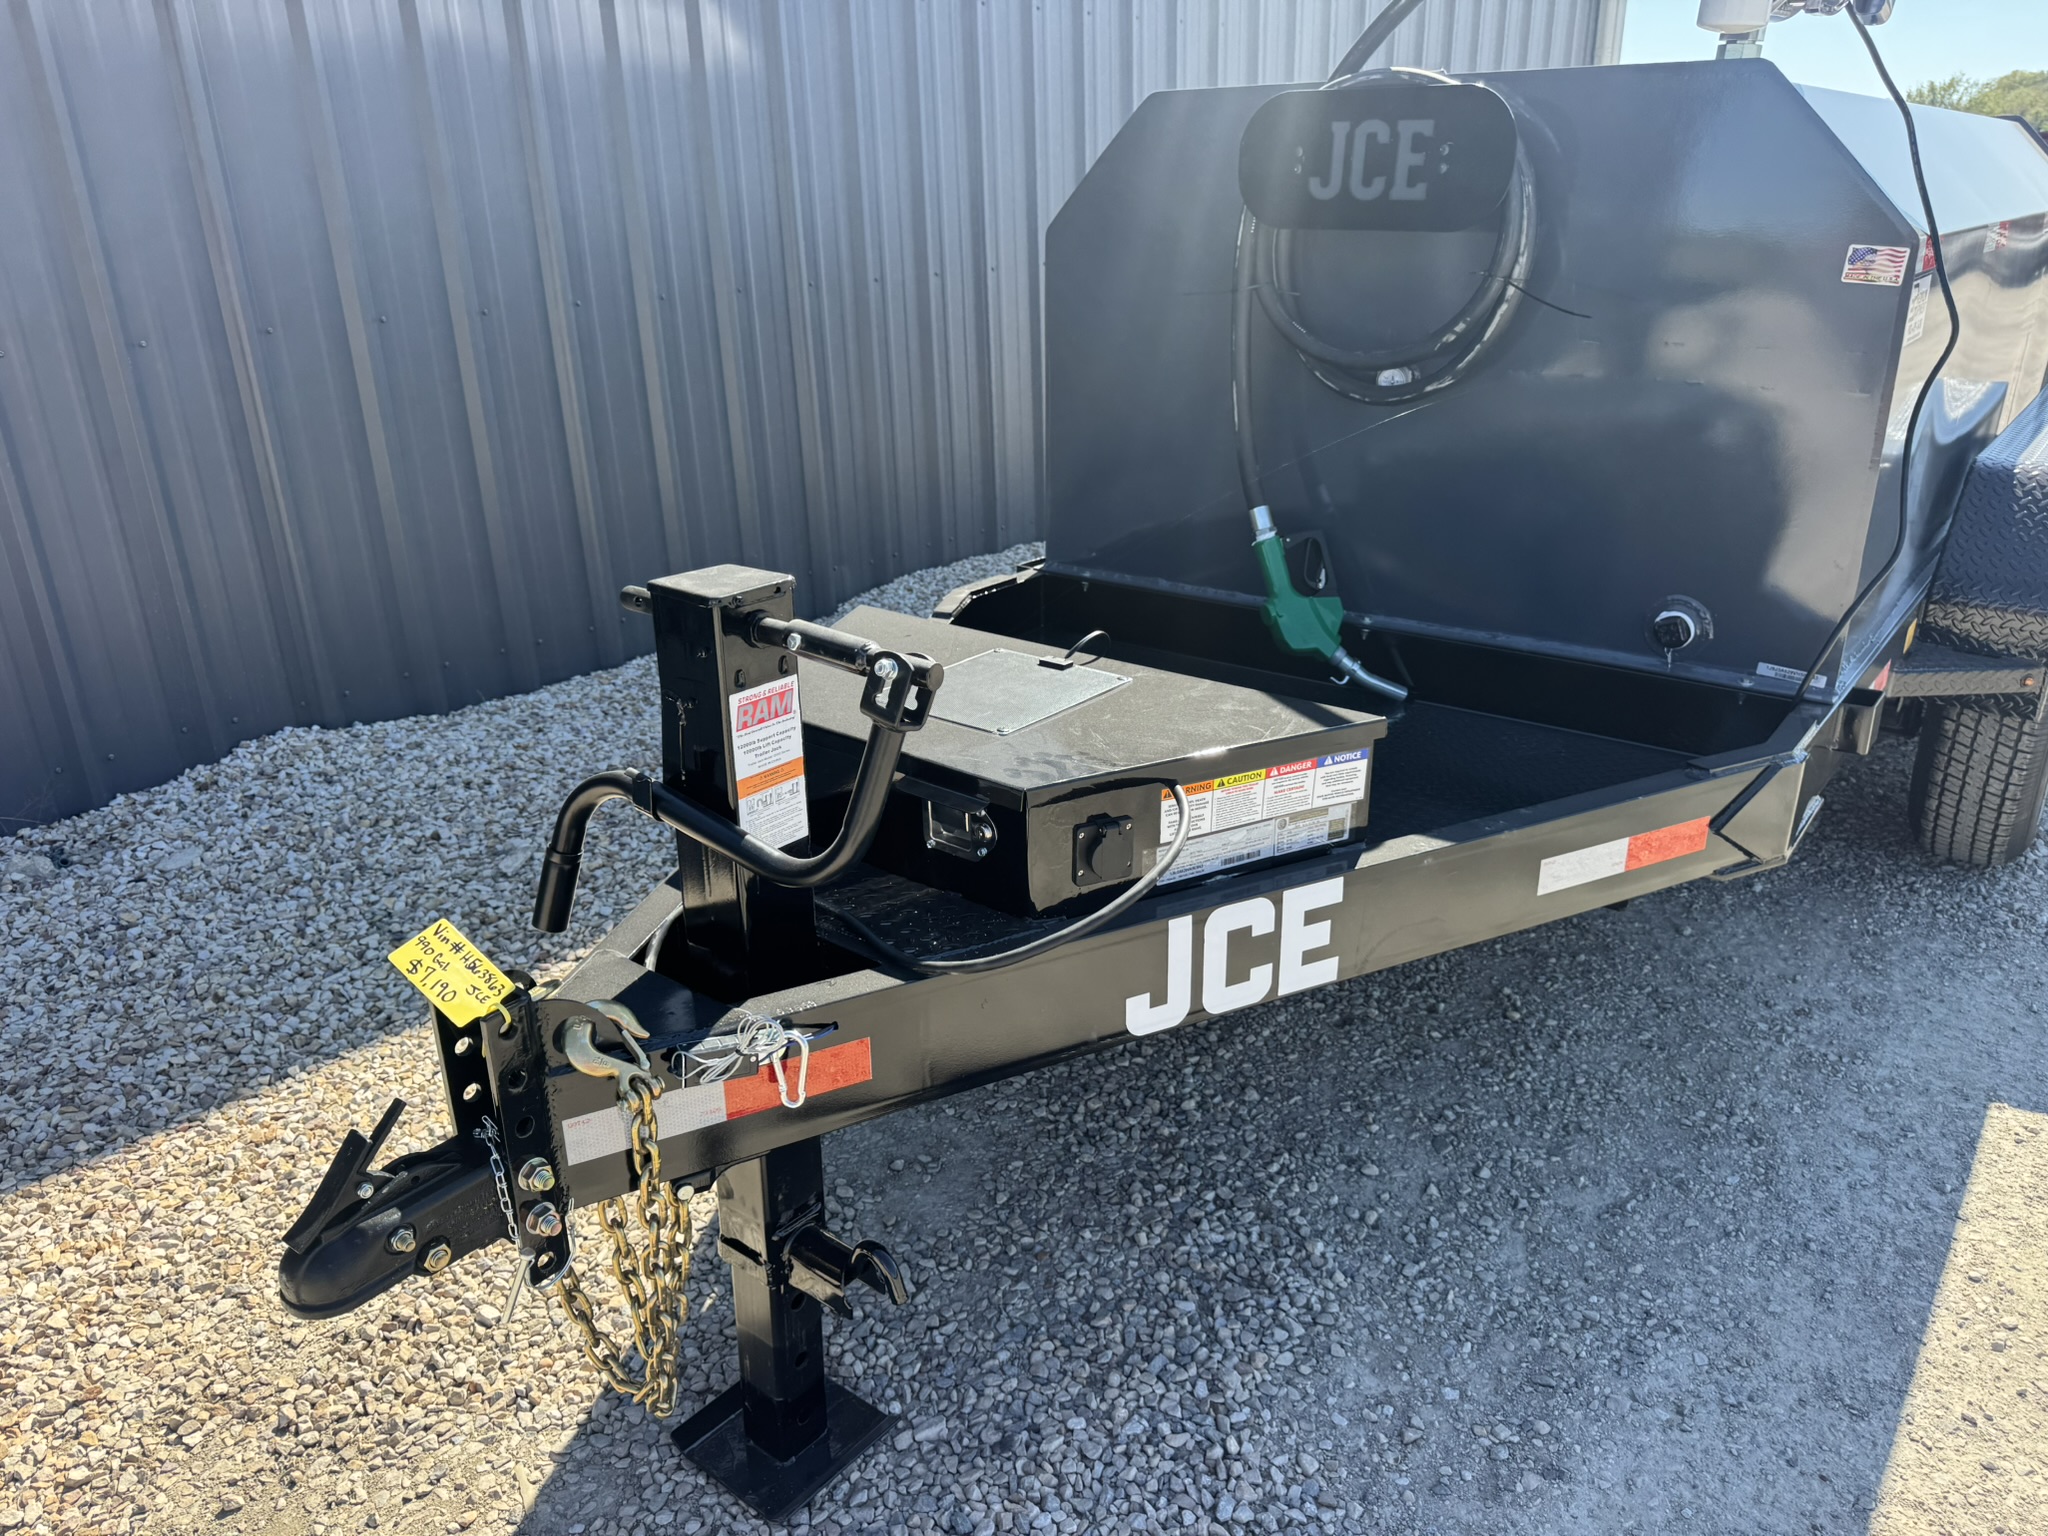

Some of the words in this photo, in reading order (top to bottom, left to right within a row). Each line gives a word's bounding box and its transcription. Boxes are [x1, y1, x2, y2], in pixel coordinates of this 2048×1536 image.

[1309, 119, 1435, 200] JCE
[738, 690, 761, 704] STRONG
[767, 681, 795, 695] RELIABLE
[737, 690, 793, 730] RAM
[757, 733, 776, 743] Support
[776, 726, 796, 736] Capacity
[763, 741, 771, 749] Lift
[772, 735, 792, 745] Capacity
[754, 750, 770, 758] Trailer
[770, 745, 782, 753] Jack
[1334, 751, 1362, 763] NOTICE
[1280, 761, 1312, 774] DANGER
[1226, 772, 1262, 785] CAUTION
[1185, 782, 1212, 794] RNING
[415, 935, 435, 956] 990
[1126, 876, 1344, 1036] JCE
[406, 959, 457, 1003] $7,190
